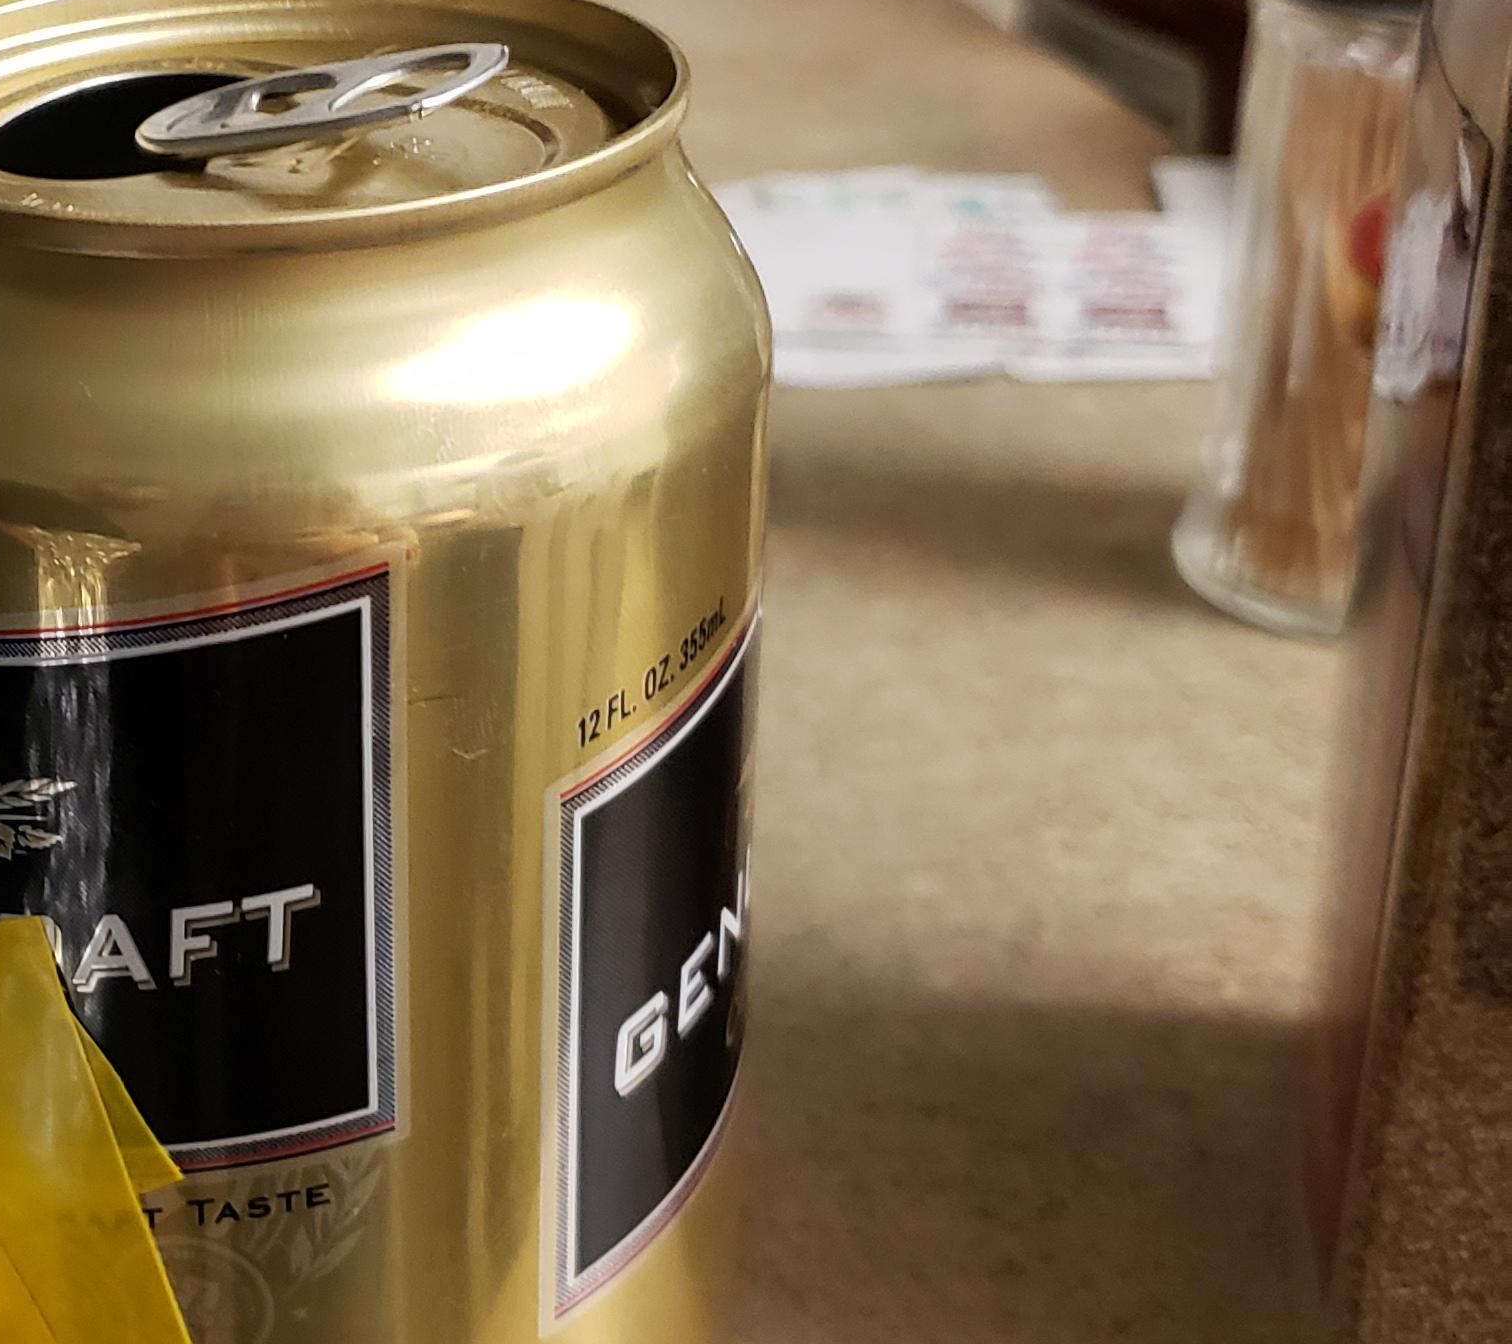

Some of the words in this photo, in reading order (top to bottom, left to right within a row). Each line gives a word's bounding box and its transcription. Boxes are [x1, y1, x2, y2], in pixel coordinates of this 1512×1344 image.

[578, 709, 601, 748] 12
[607, 688, 637, 730] FL.
[644, 654, 675, 701] OZ.
[614, 843, 751, 1097] GEN
[187, 1183, 331, 1226] TASTE
